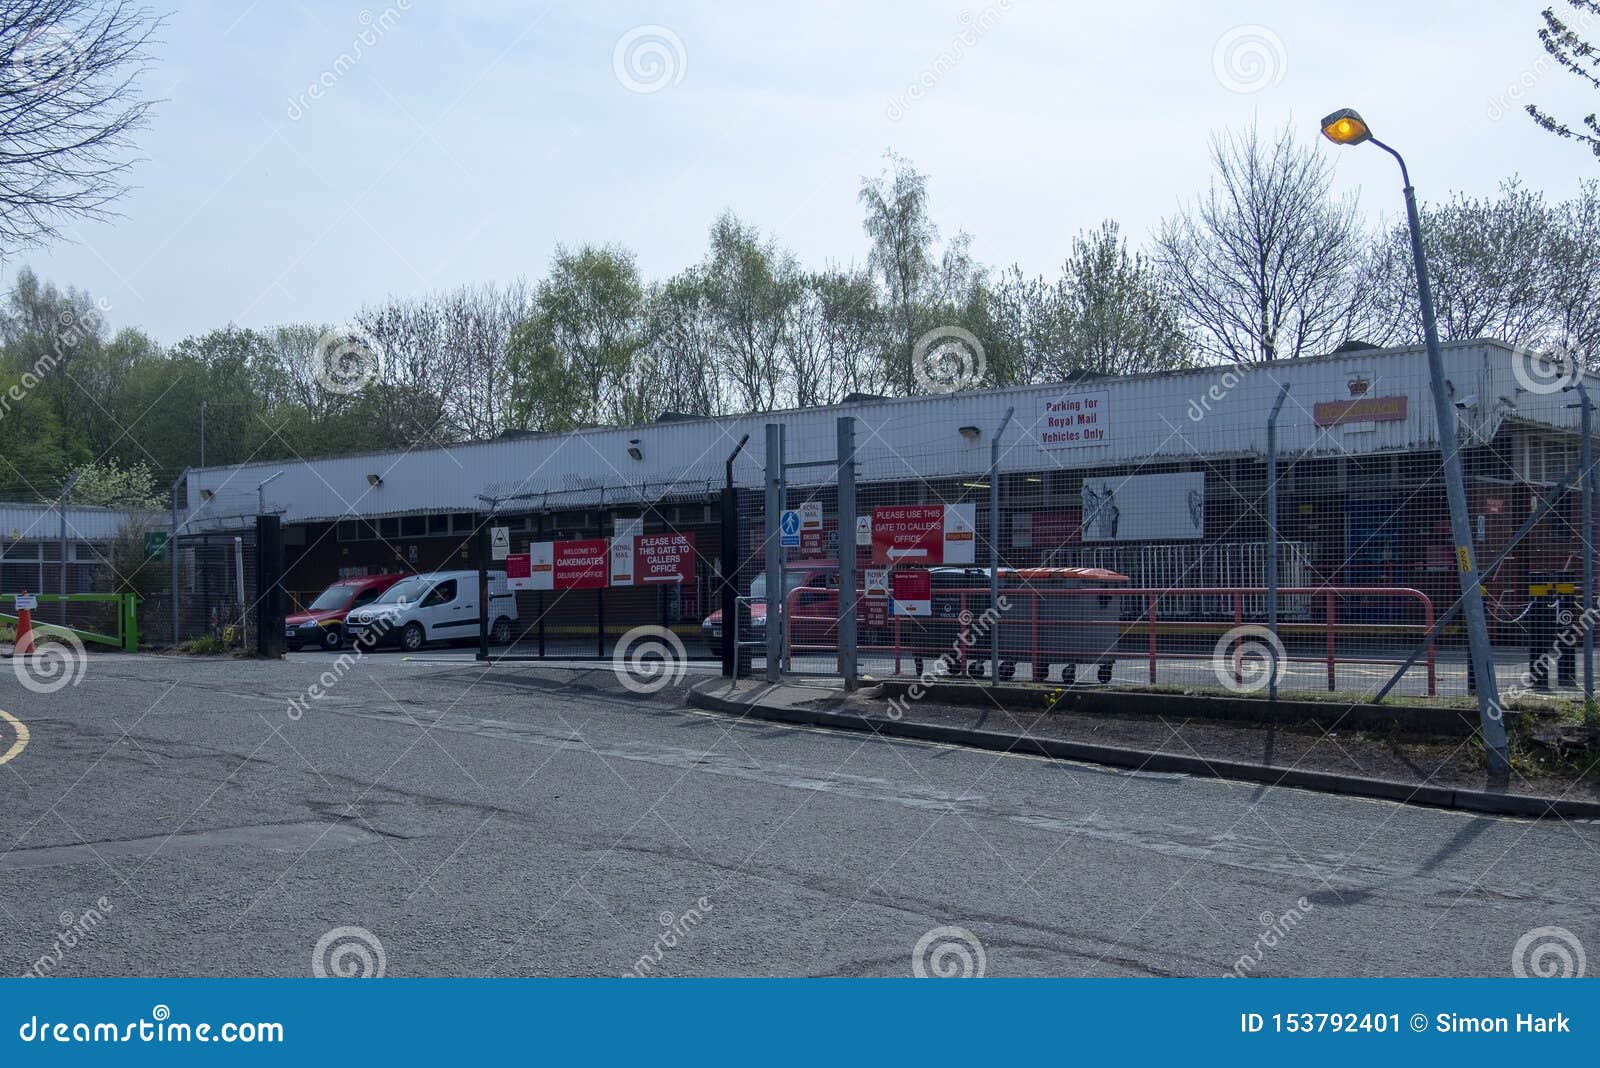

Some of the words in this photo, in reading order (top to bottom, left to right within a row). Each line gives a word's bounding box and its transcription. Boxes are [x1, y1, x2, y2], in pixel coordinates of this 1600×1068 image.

[1046, 400, 1080, 411] Parking
[1085, 398, 1098, 408] for
[1048, 416, 1073, 428] Royal
[1077, 412, 1097, 424] Mail
[1042, 431, 1080, 443] Vehicles
[1083, 428, 1104, 440] Only
[877, 510, 905, 519] PLEASE
[906, 510, 922, 518] USE
[923, 509, 941, 518] THIS
[875, 523, 895, 531] GATE
[896, 522, 907, 531] TO
[907, 521, 941, 531] CALLERS
[641, 537, 669, 546] PLEASE
[671, 536, 688, 545] USE
[894, 534, 921, 543] OFFICE
[563, 547, 589, 555] WELCOME
[639, 546, 655, 555] THIS
[657, 546, 677, 554] GATE
[679, 544, 690, 553] TO
[556, 556, 604, 567] OAKENGATES
[647, 555, 681, 564] CALLERS
[650, 564, 677, 573] OFFICE
[557, 571, 584, 579] DELIVERY
[584, 570, 603, 578] OFFICE
